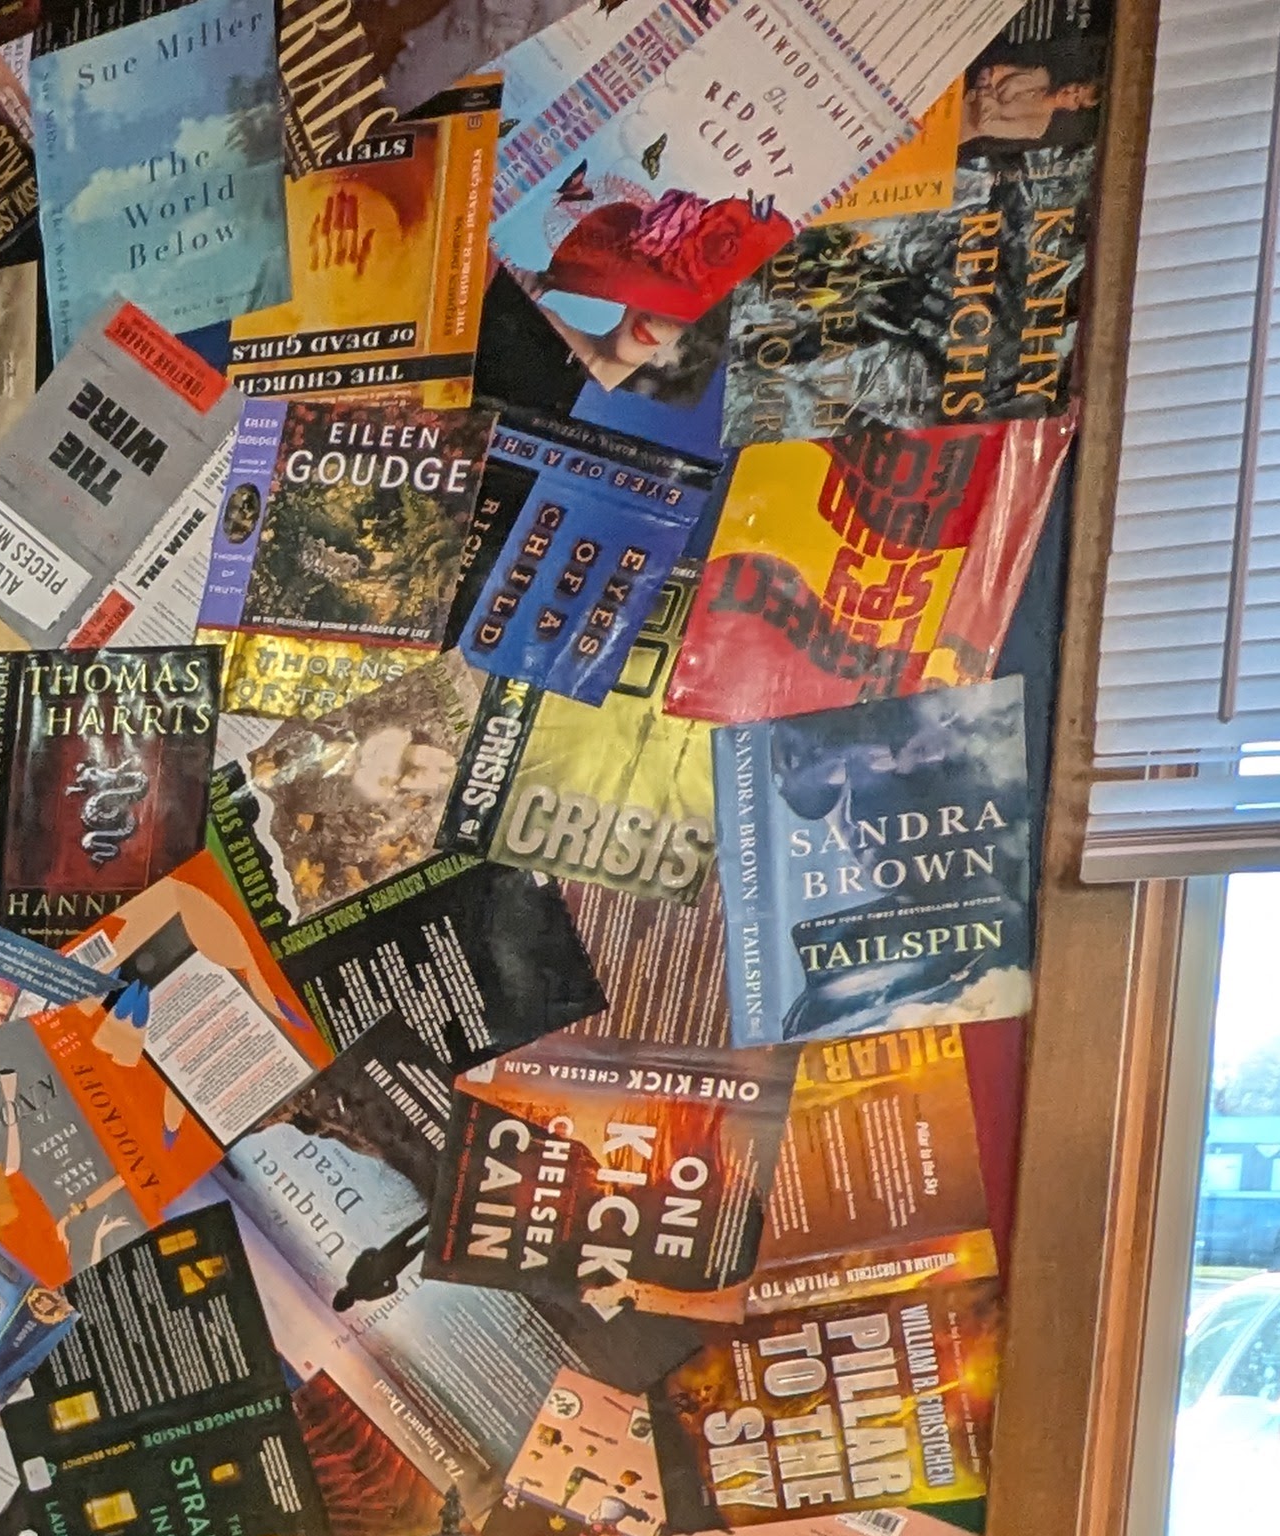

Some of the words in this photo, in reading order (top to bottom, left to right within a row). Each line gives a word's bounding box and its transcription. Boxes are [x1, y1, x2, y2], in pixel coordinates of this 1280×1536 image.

[77, 62, 138, 90] Sue
[157, 10, 263, 59] Miller
[698, 119, 752, 177] CLUB
[703, 80, 754, 119] RED
[758, 126, 794, 180] HAT
[820, 94, 875, 151] SMITH
[123, 176, 235, 228] World
[142, 150, 210, 184] The
[129, 223, 234, 270] Below
[943, 211, 1004, 416] REICHS
[1016, 207, 1074, 402] KATHY
[67, 380, 168, 477] WIRE
[328, 422, 439, 450] EILEEN
[49, 431, 124, 507] THE
[286, 451, 471, 494] GOUDGE
[25, 660, 201, 695] THOMAS
[49, 703, 211, 735] HARRIS
[505, 784, 712, 891] CRISIS
[789, 801, 1007, 859] SANDRA
[802, 845, 996, 901] BROWN
[800, 921, 1004, 973] TAILSPIN
[466, 1118, 530, 1261] CAIN
[520, 1115, 573, 1270] CHELSEA
[577, 1122, 657, 1280] KICK
[653, 1156, 707, 1260] ONE
[759, 1324, 826, 1396] TO
[826, 1314, 913, 1500] PILLAR
[703, 1408, 777, 1510] SKY
[773, 1406, 845, 1508] THE
